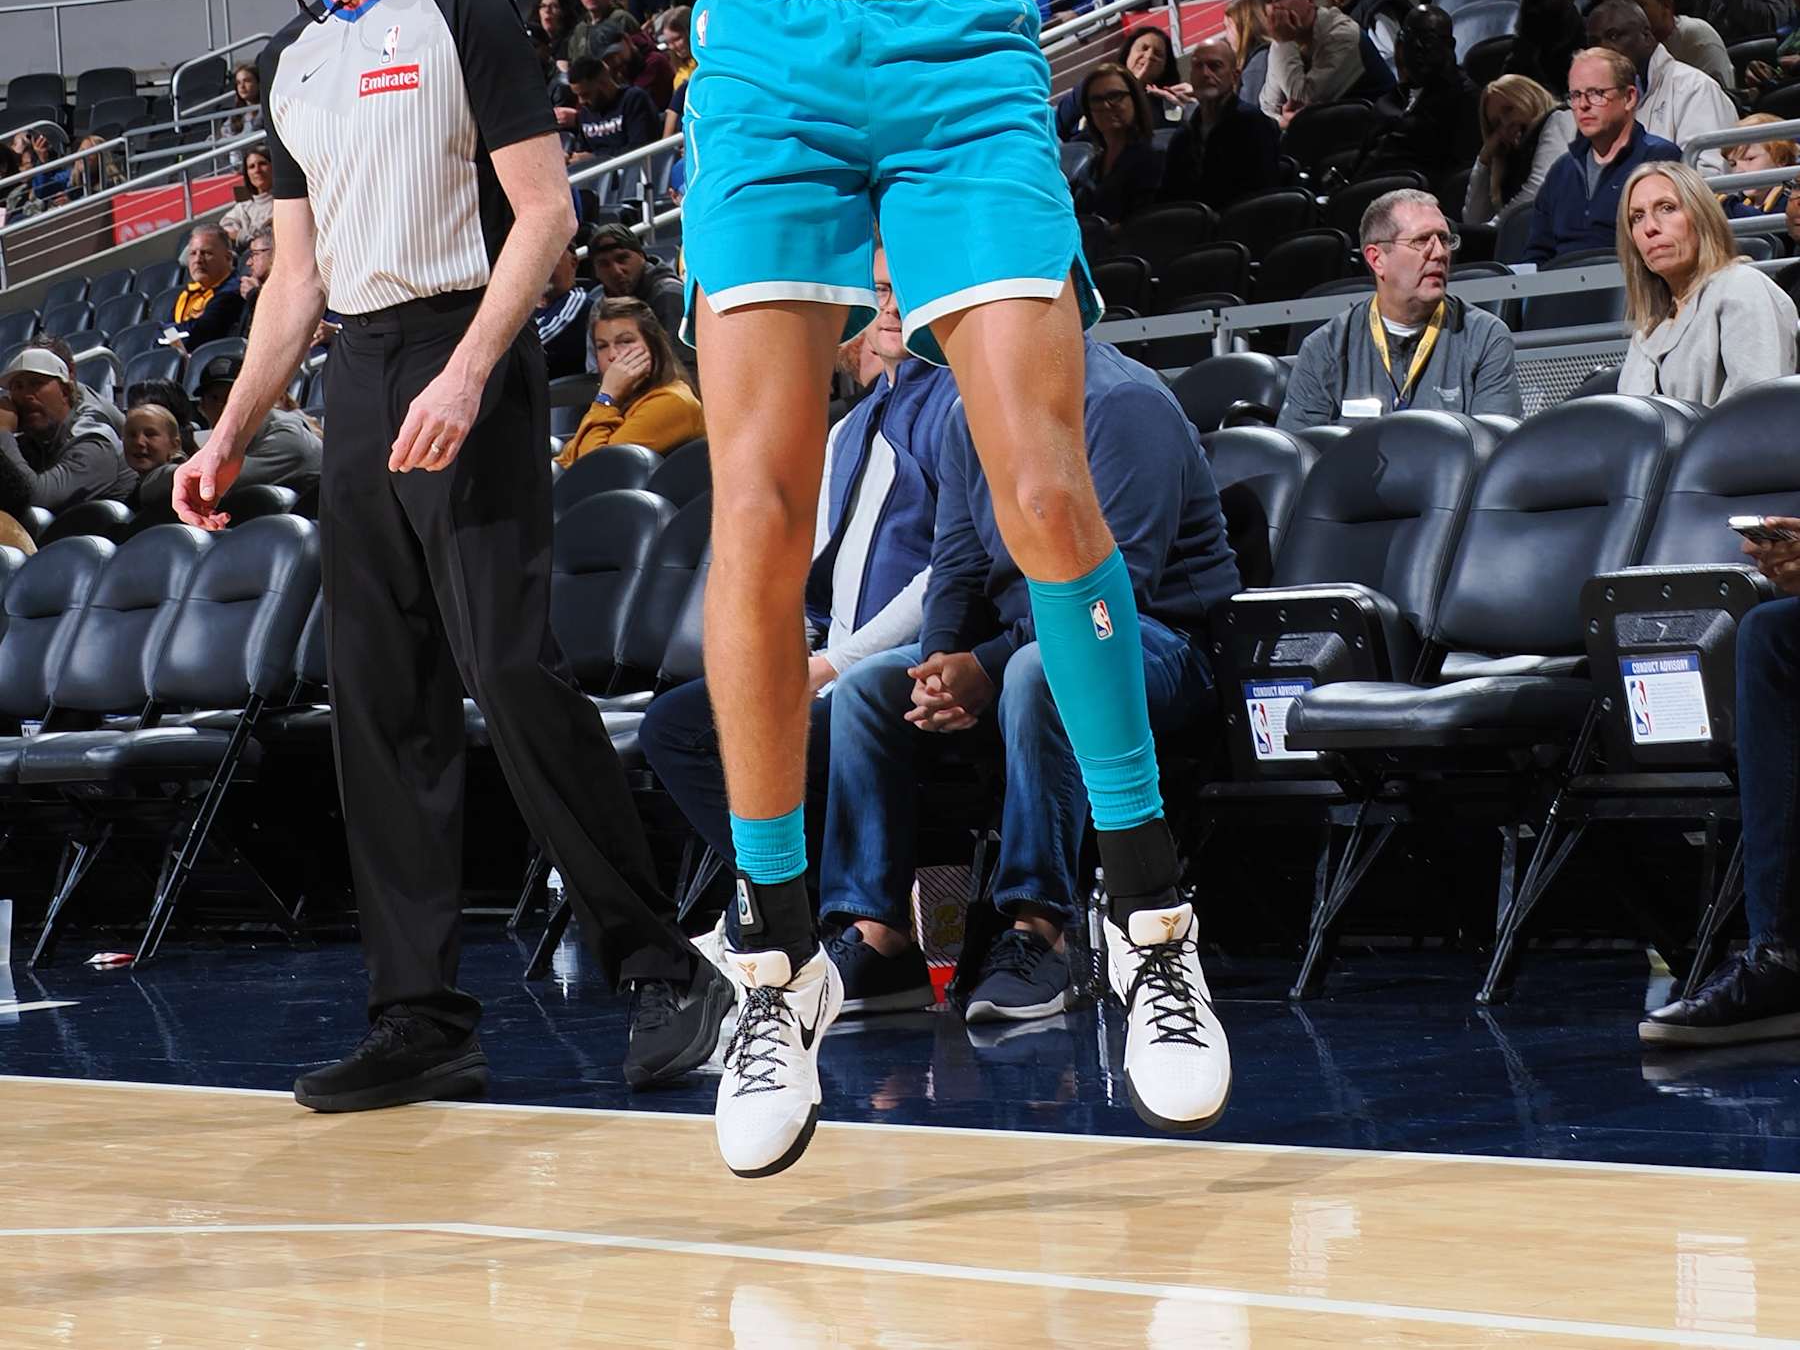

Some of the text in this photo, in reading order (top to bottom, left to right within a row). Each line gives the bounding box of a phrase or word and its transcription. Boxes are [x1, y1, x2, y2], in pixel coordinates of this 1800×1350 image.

[360, 71, 418, 92] Emirates
[1631, 659, 1689, 674] CONDUCT ADVISORY
